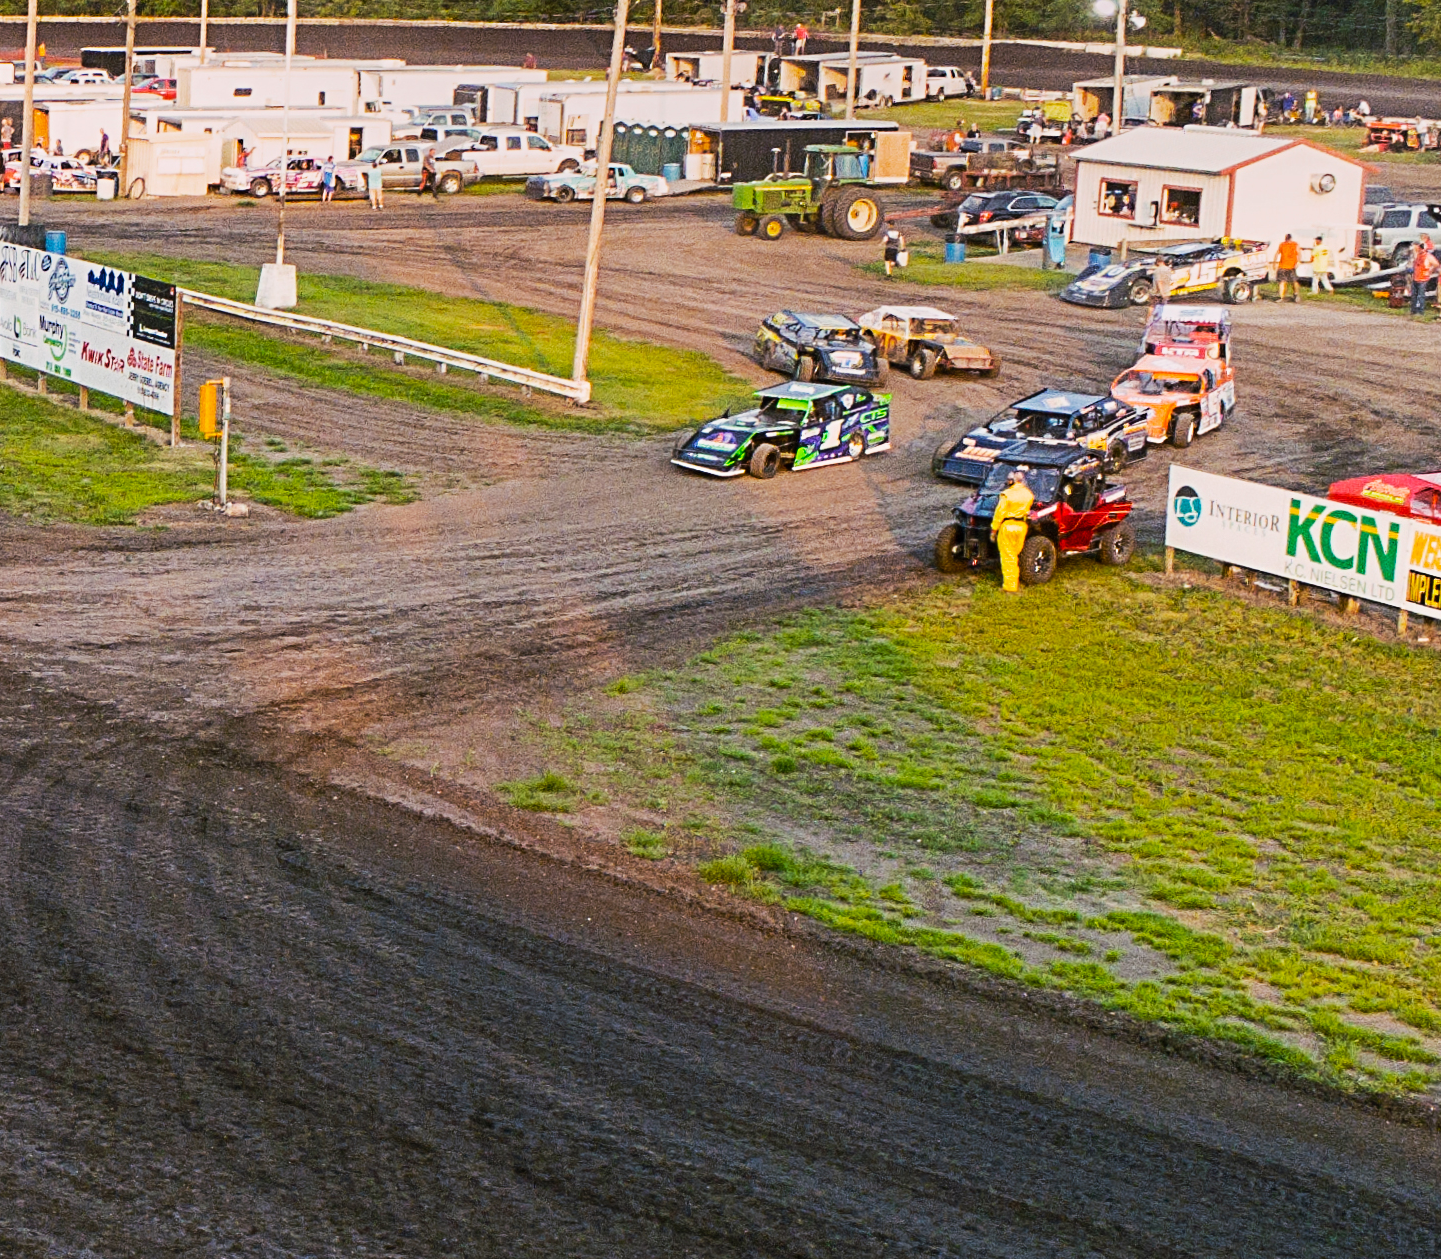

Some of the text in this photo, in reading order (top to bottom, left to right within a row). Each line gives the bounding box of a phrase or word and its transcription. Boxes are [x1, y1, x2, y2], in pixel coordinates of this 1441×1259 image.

[39, 314, 64, 339] Murphy
[137, 350, 173, 379] State Farm
[859, 407, 889, 424] CTS
[820, 418, 845, 451] 1
[1209, 500, 1281, 533] INTERIOR
[1285, 498, 1401, 583] KCN
[1310, 569, 1367, 594] NIELSEN
[1370, 585, 1396, 602] LTD
